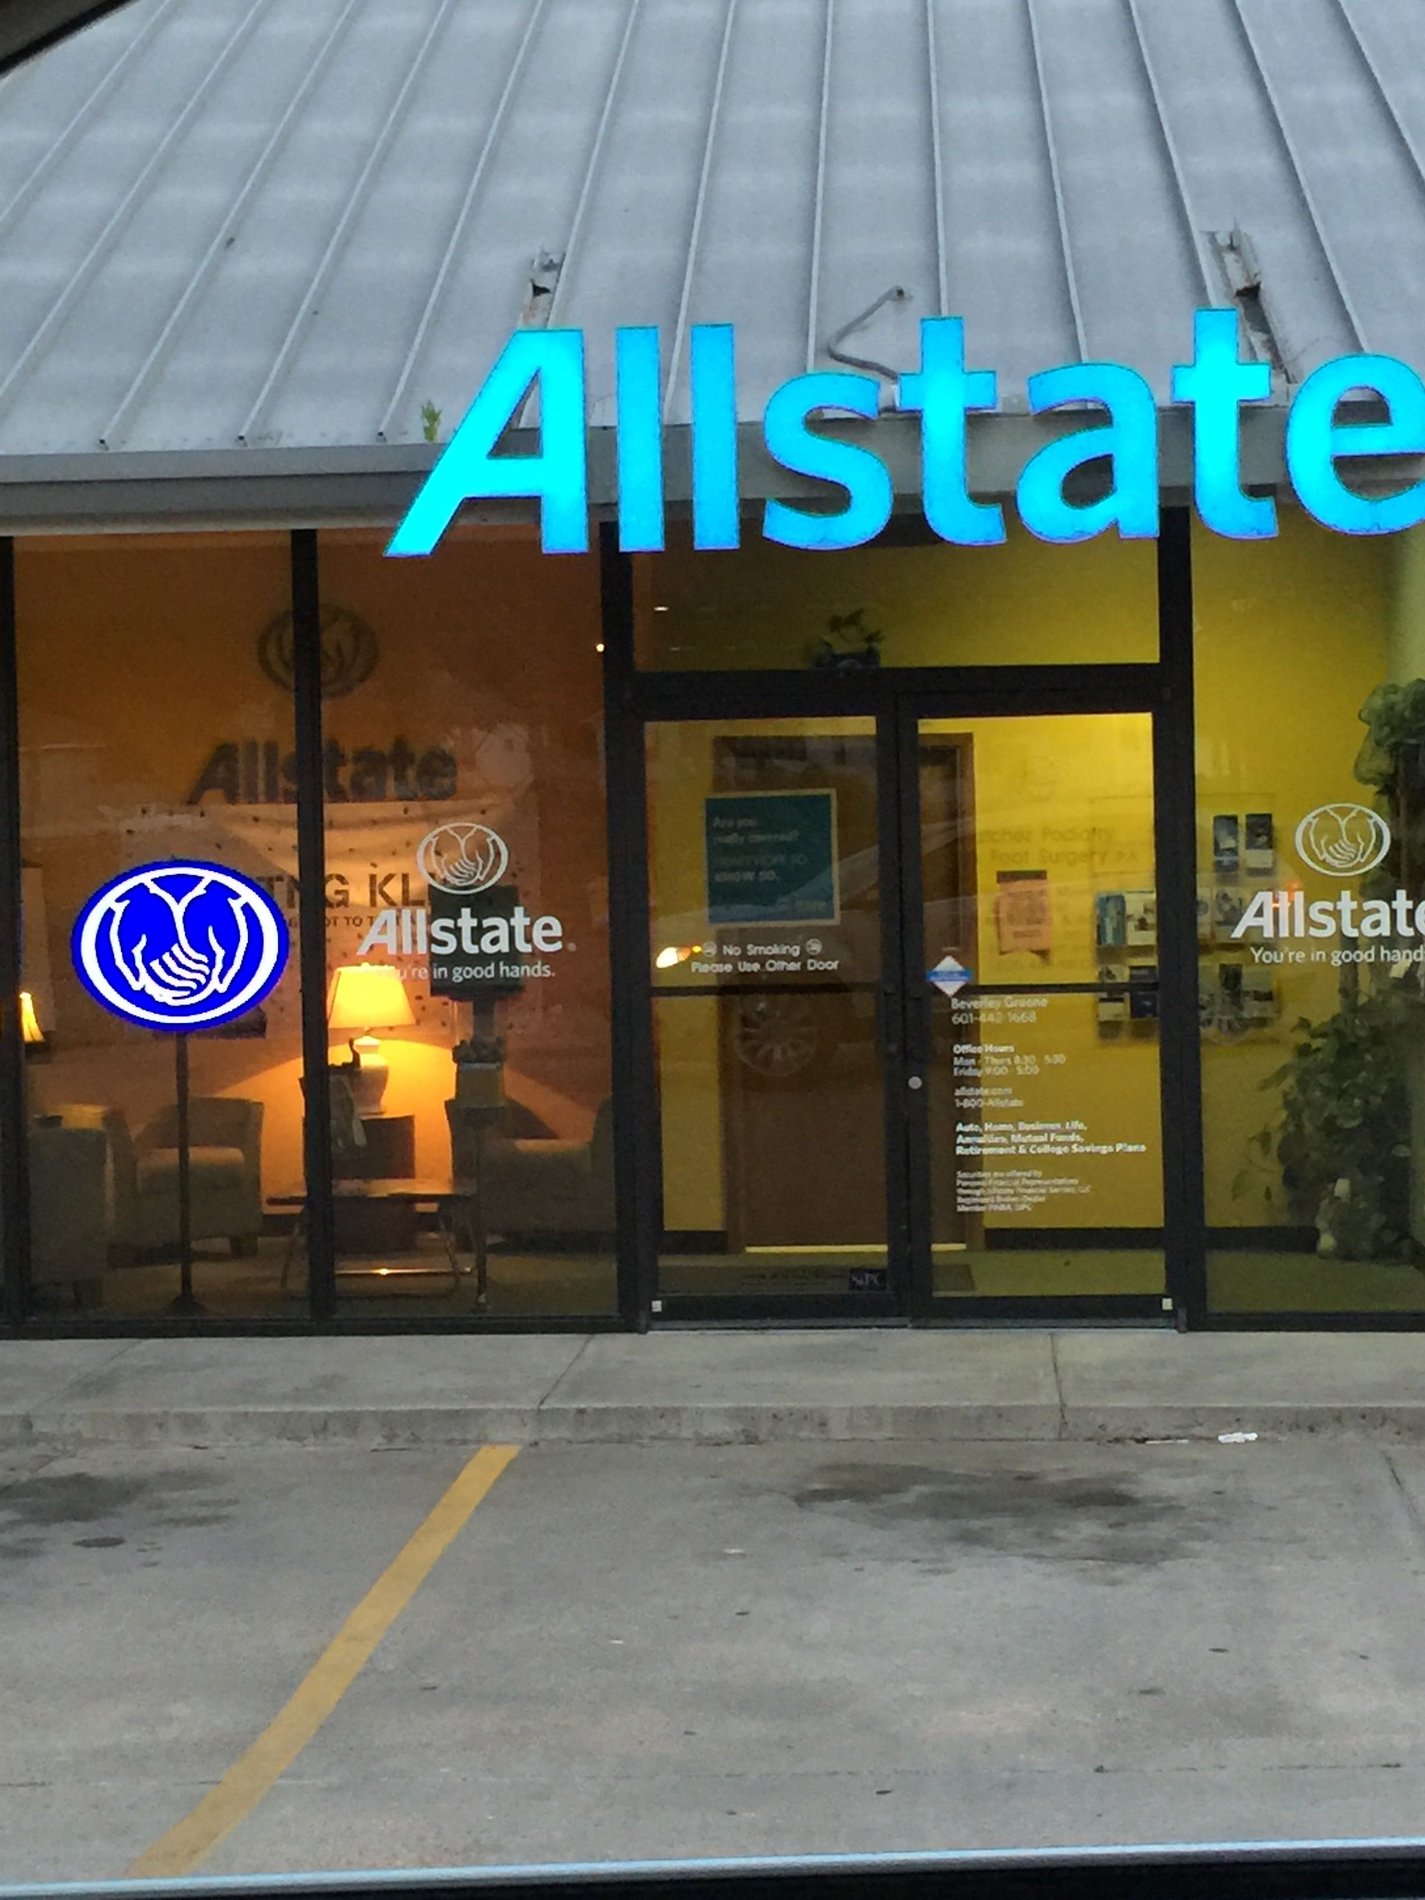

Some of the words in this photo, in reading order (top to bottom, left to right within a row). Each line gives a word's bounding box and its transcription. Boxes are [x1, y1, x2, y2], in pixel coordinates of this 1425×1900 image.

[384, 308, 1425, 557] Allstate
[356, 906, 563, 956] Allstate
[723, 944, 742, 957] No
[746, 943, 801, 957] Smoking
[1251, 946, 1306, 964] You're
[1311, 947, 1326, 962] in
[1331, 945, 1375, 967] good
[1380, 945, 1425, 964] hand
[433, 963, 448, 979] in
[452, 962, 495, 983] good
[499, 960, 556, 978] hands.
[691, 961, 733, 973] Please
[738, 961, 761, 973] Use
[765, 959, 801, 972] Other
[806, 959, 840, 971] Door
